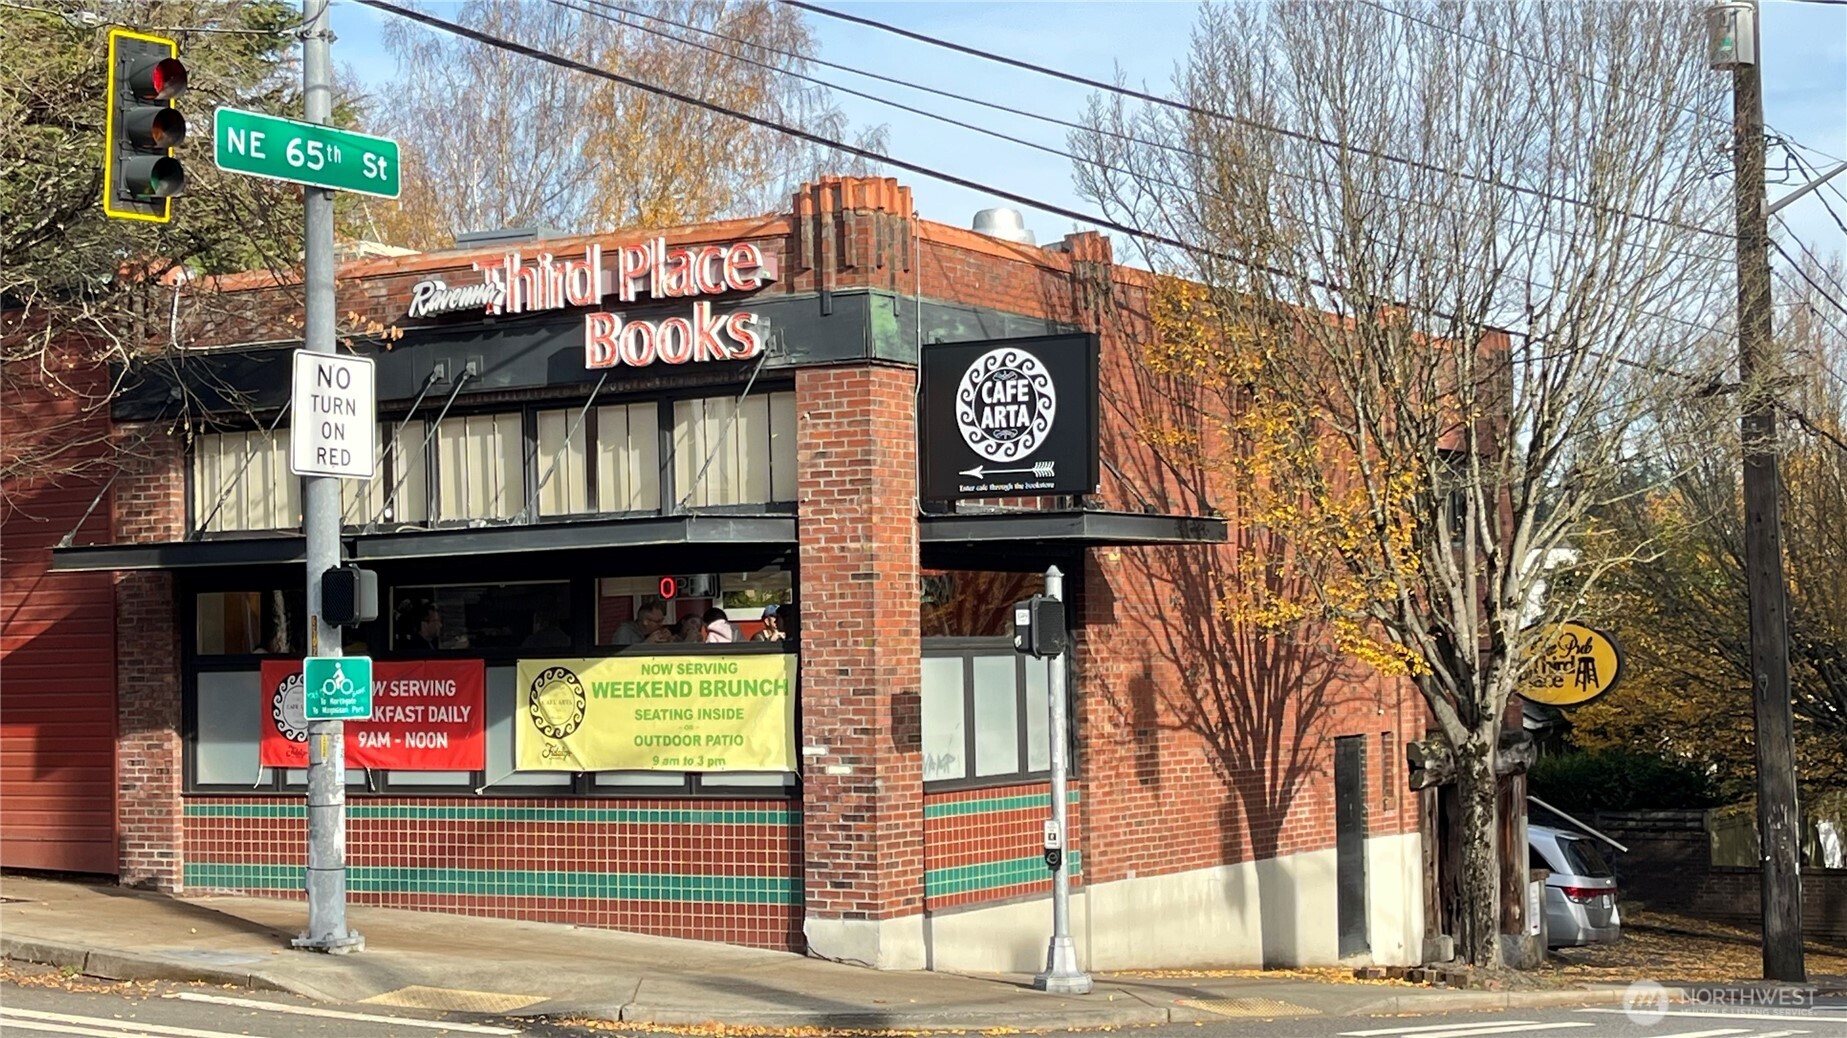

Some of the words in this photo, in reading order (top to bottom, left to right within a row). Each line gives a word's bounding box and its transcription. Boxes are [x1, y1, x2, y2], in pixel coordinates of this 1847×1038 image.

[227, 126, 266, 160] NE
[286, 137, 342, 171] 65th
[362, 152, 388, 181] St
[408, 280, 505, 318] Ravenna
[473, 243, 602, 315] Third
[618, 236, 763, 302] Place
[585, 301, 761, 370] Books
[317, 363, 351, 390] NO
[981, 378, 1030, 404] CAFE
[311, 394, 356, 417] TURN
[981, 404, 1031, 429] ARTA
[321, 421, 345, 440] ON
[317, 447, 351, 466] RED
[1014, 482, 1024, 490] the
[1557, 632, 1593, 659] Pub
[641, 664, 673, 676] NOW
[677, 662, 738, 675] SERVING
[390, 679, 456, 697] SERVING
[592, 681, 693, 699] WEEKEND
[700, 679, 789, 697] BRUNCH
[347, 705, 425, 723] KFAST
[428, 705, 472, 723] DAILY
[634, 708, 694, 721] SEATING
[698, 708, 744, 720] INSIDE
[358, 731, 390, 748] 9AM
[405, 732, 448, 749] NOON
[634, 735, 701, 747] OUTDOOR
[705, 735, 744, 746] PATIO
[652, 756, 660, 766] 9
[662, 757, 680, 766] am
[683, 755, 694, 766] to
[697, 756, 704, 766] 3
[707, 757, 726, 768] pm
